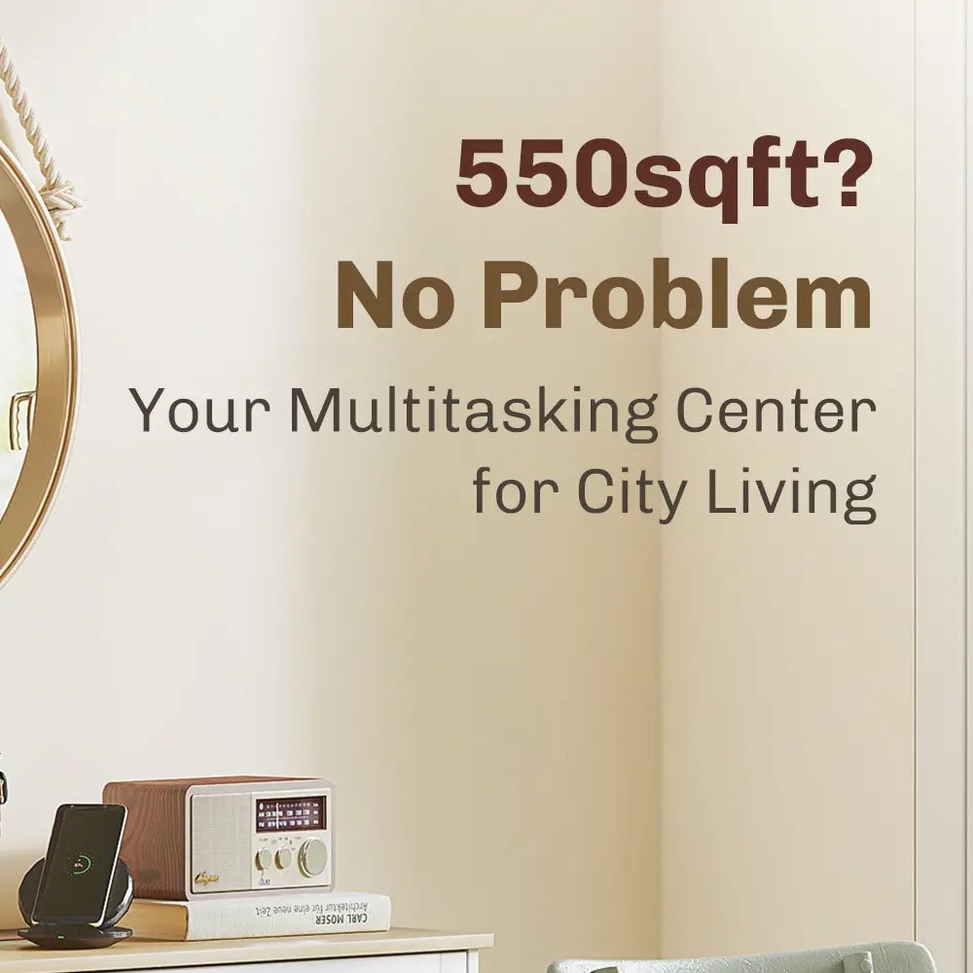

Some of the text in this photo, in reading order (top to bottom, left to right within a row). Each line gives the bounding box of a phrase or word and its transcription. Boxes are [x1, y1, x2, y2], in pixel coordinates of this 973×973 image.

[255, 907, 271, 918] Zeit
[273, 906, 292, 915] neue
[294, 904, 310, 915] eine
[325, 902, 368, 914] Architektur
[315, 912, 368, 925] CARL MOSER
